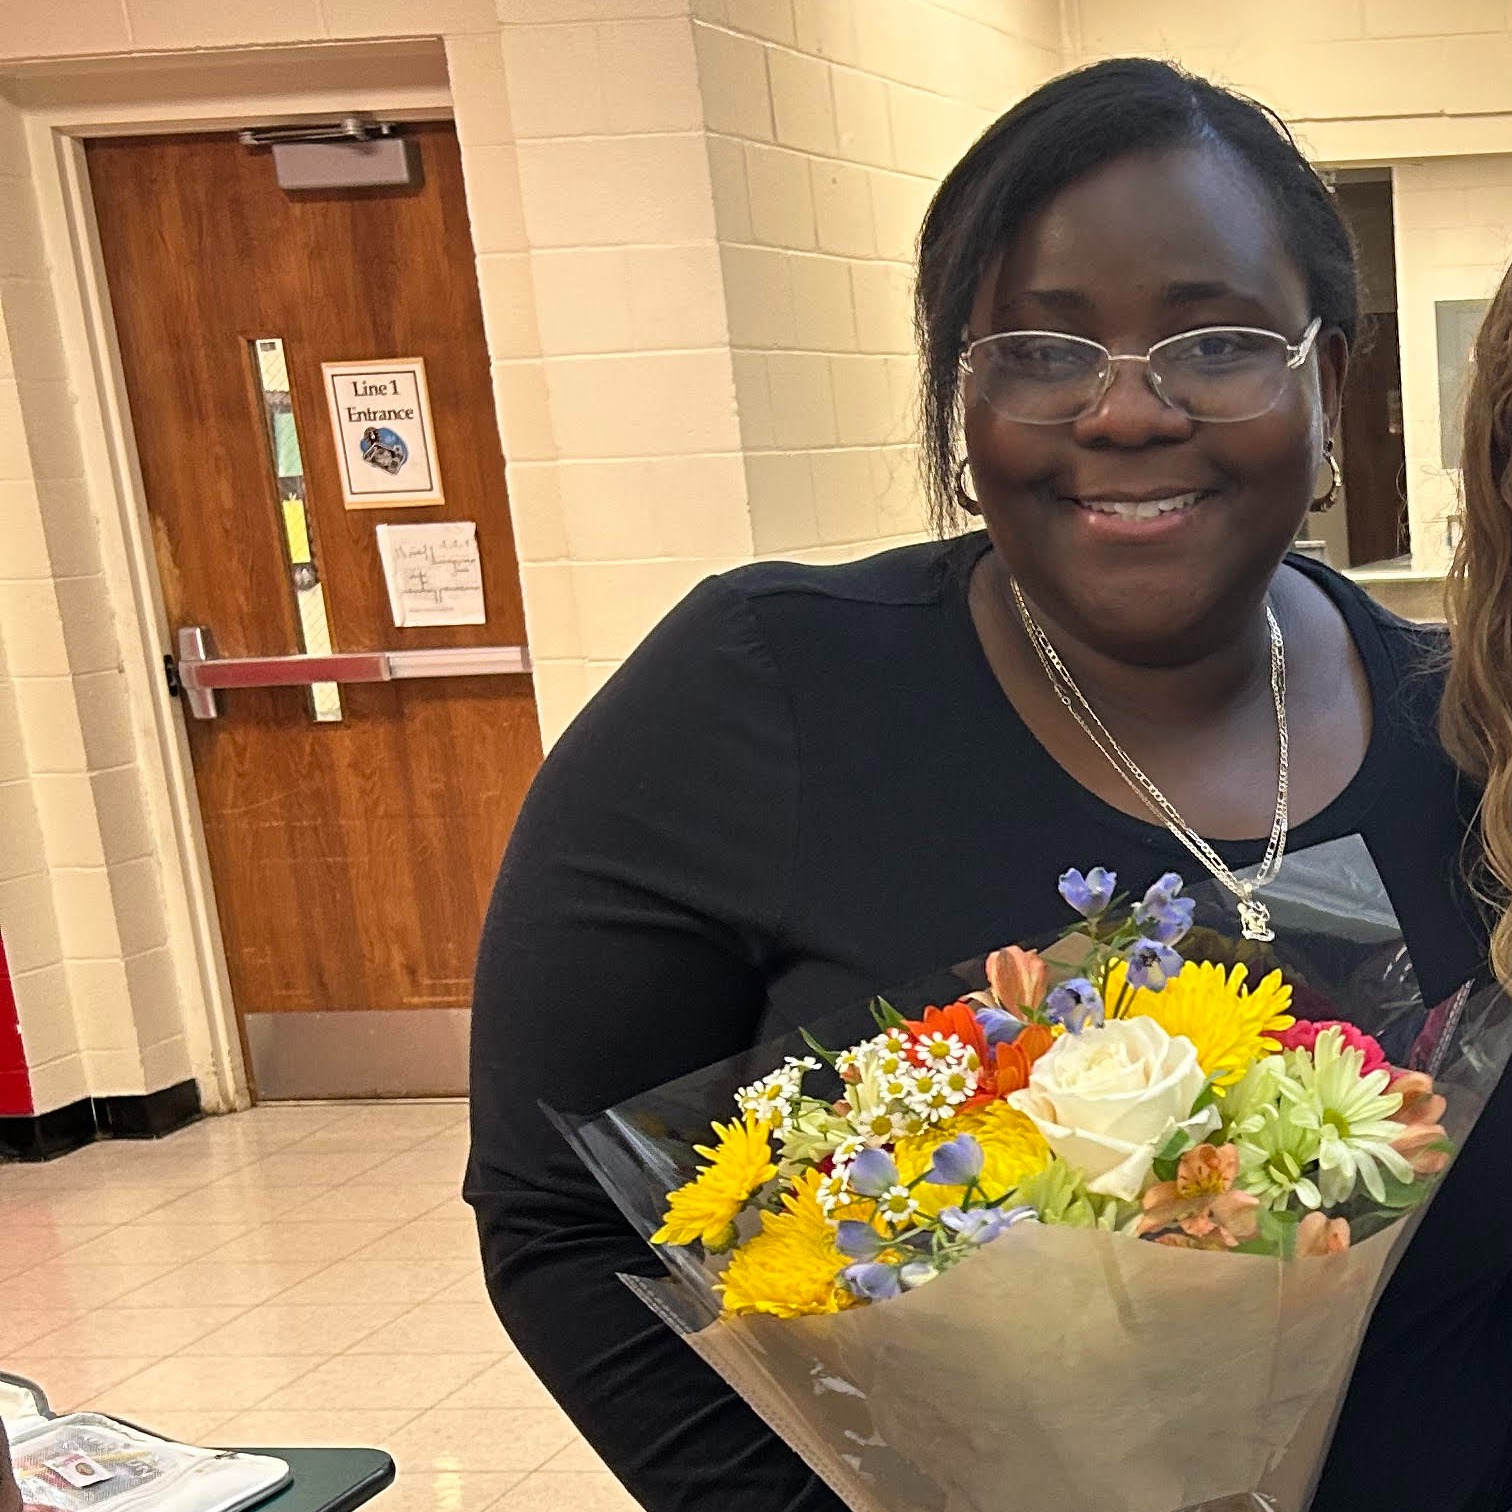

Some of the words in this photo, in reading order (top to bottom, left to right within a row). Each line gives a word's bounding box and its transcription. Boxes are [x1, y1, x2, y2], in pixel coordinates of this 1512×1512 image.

[352, 380, 388, 397] Line
[389, 380, 400, 395] 1
[346, 405, 414, 422] Entrance
